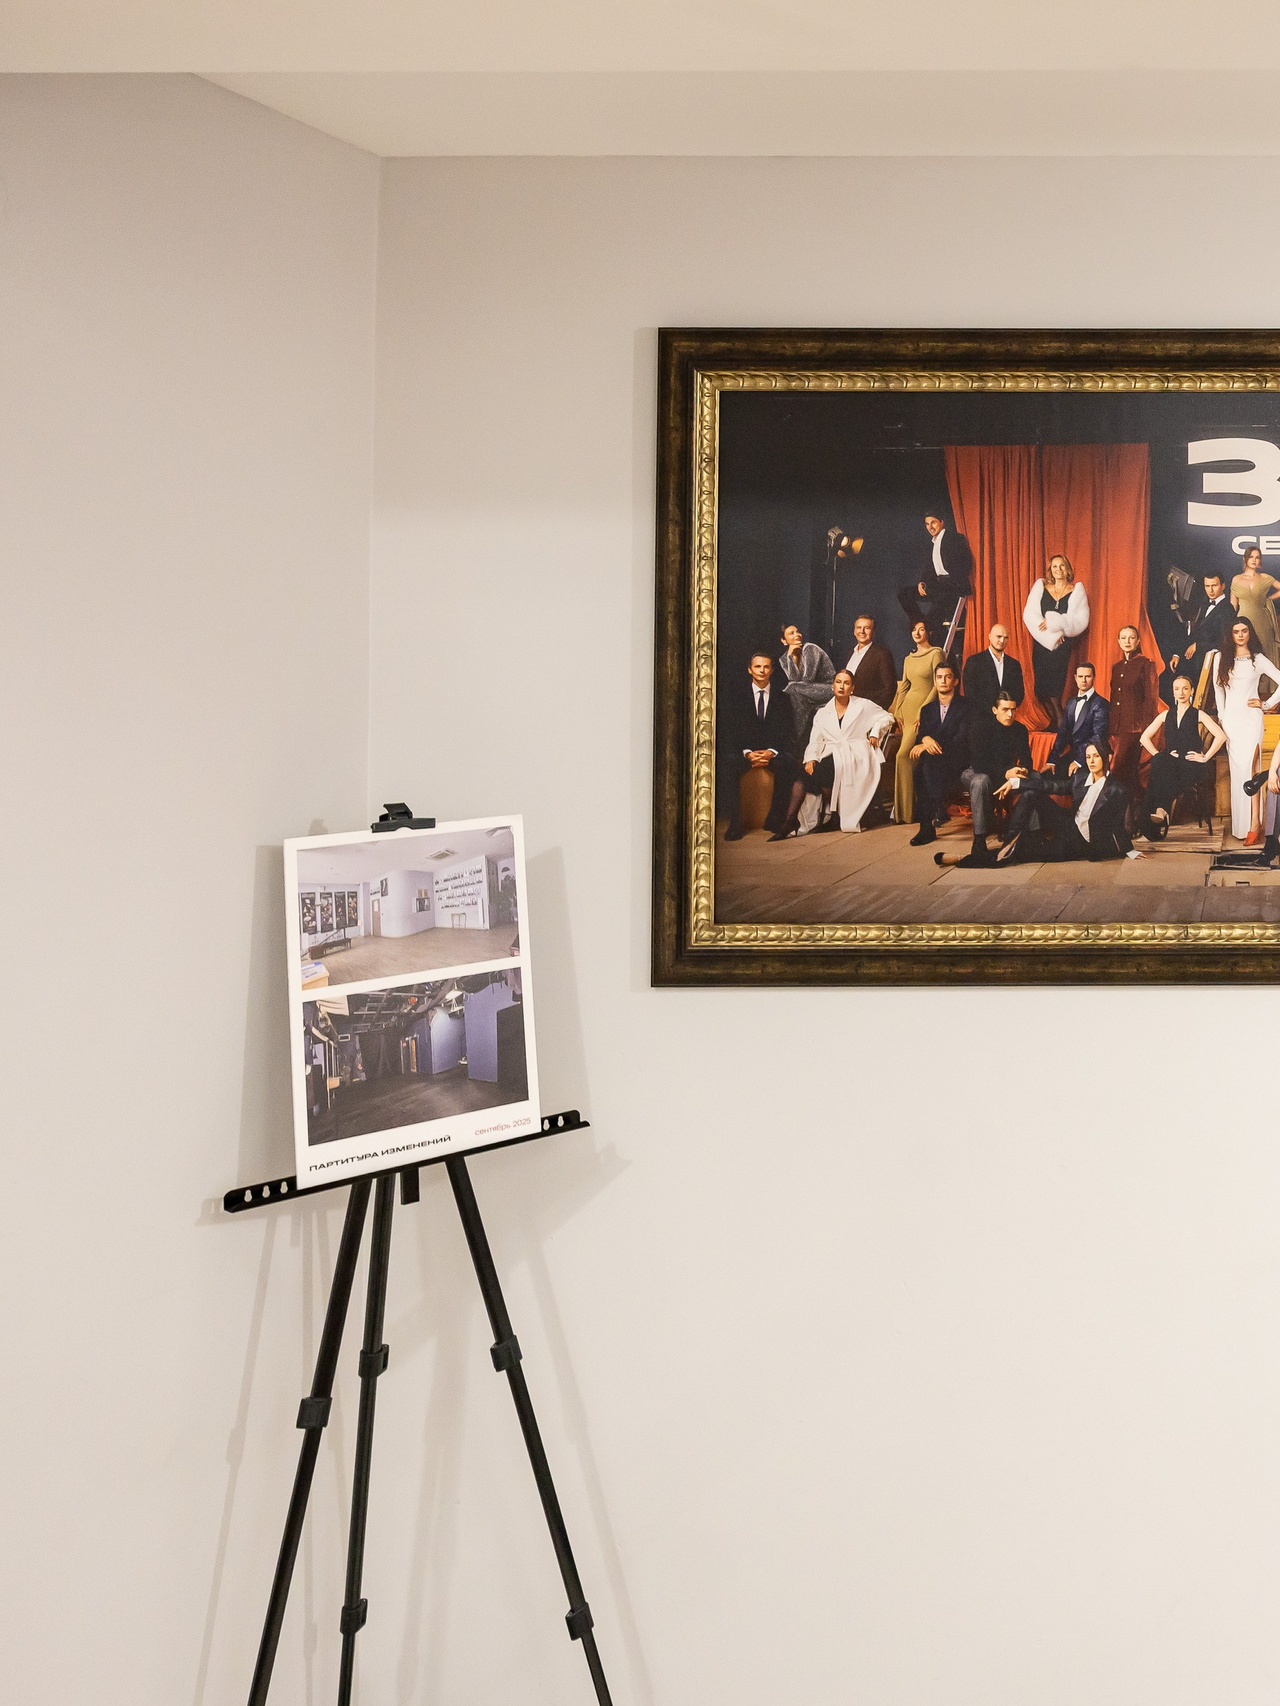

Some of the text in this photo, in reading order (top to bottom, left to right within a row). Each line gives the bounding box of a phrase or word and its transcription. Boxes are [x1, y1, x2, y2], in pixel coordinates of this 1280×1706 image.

[474, 1117, 532, 1136] сентябрь 2025
[309, 1134, 452, 1172] ПАРТИТУРА ИЗМЕНЕНИЙ
